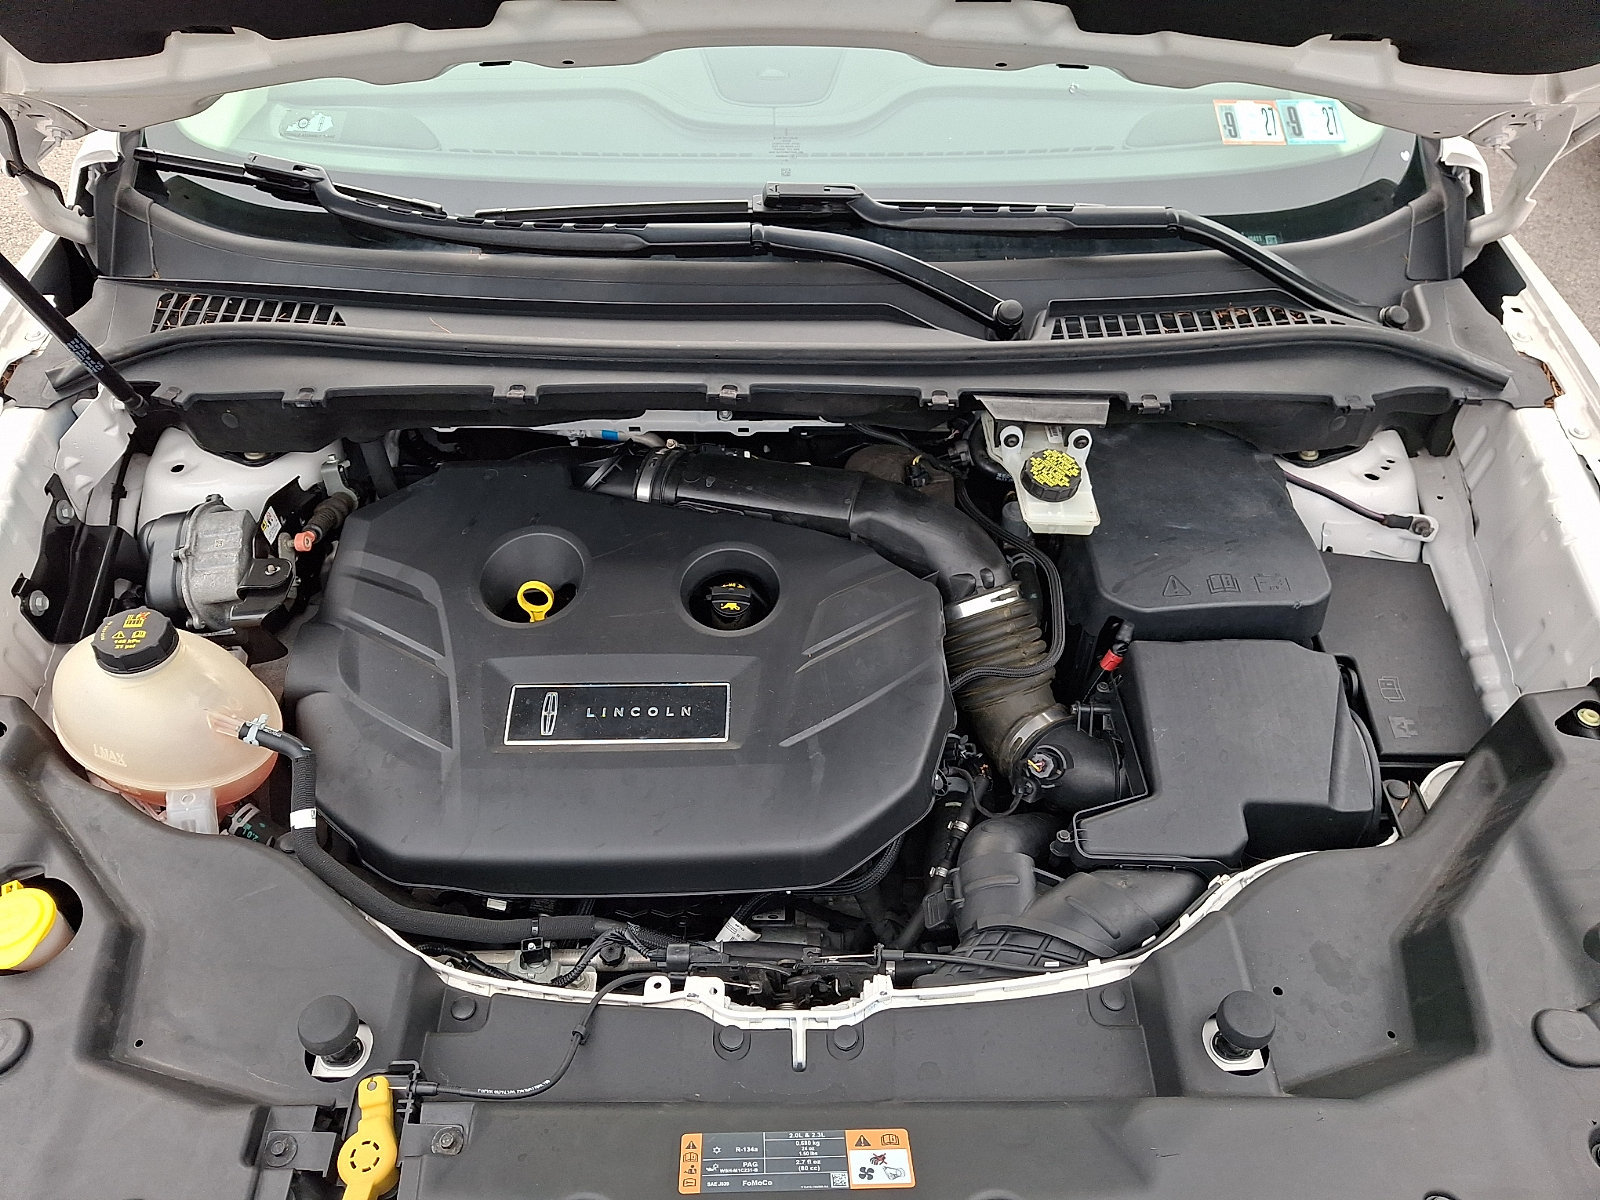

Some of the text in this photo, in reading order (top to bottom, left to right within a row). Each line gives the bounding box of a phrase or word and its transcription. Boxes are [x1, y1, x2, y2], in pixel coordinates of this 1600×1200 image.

[1261, 107, 1277, 136] 27
[1321, 106, 1338, 136] 27
[586, 706, 692, 718] LINCOLN
[809, 1164, 821, 1172] cc)
[742, 1179, 773, 1187] FoMoCo
